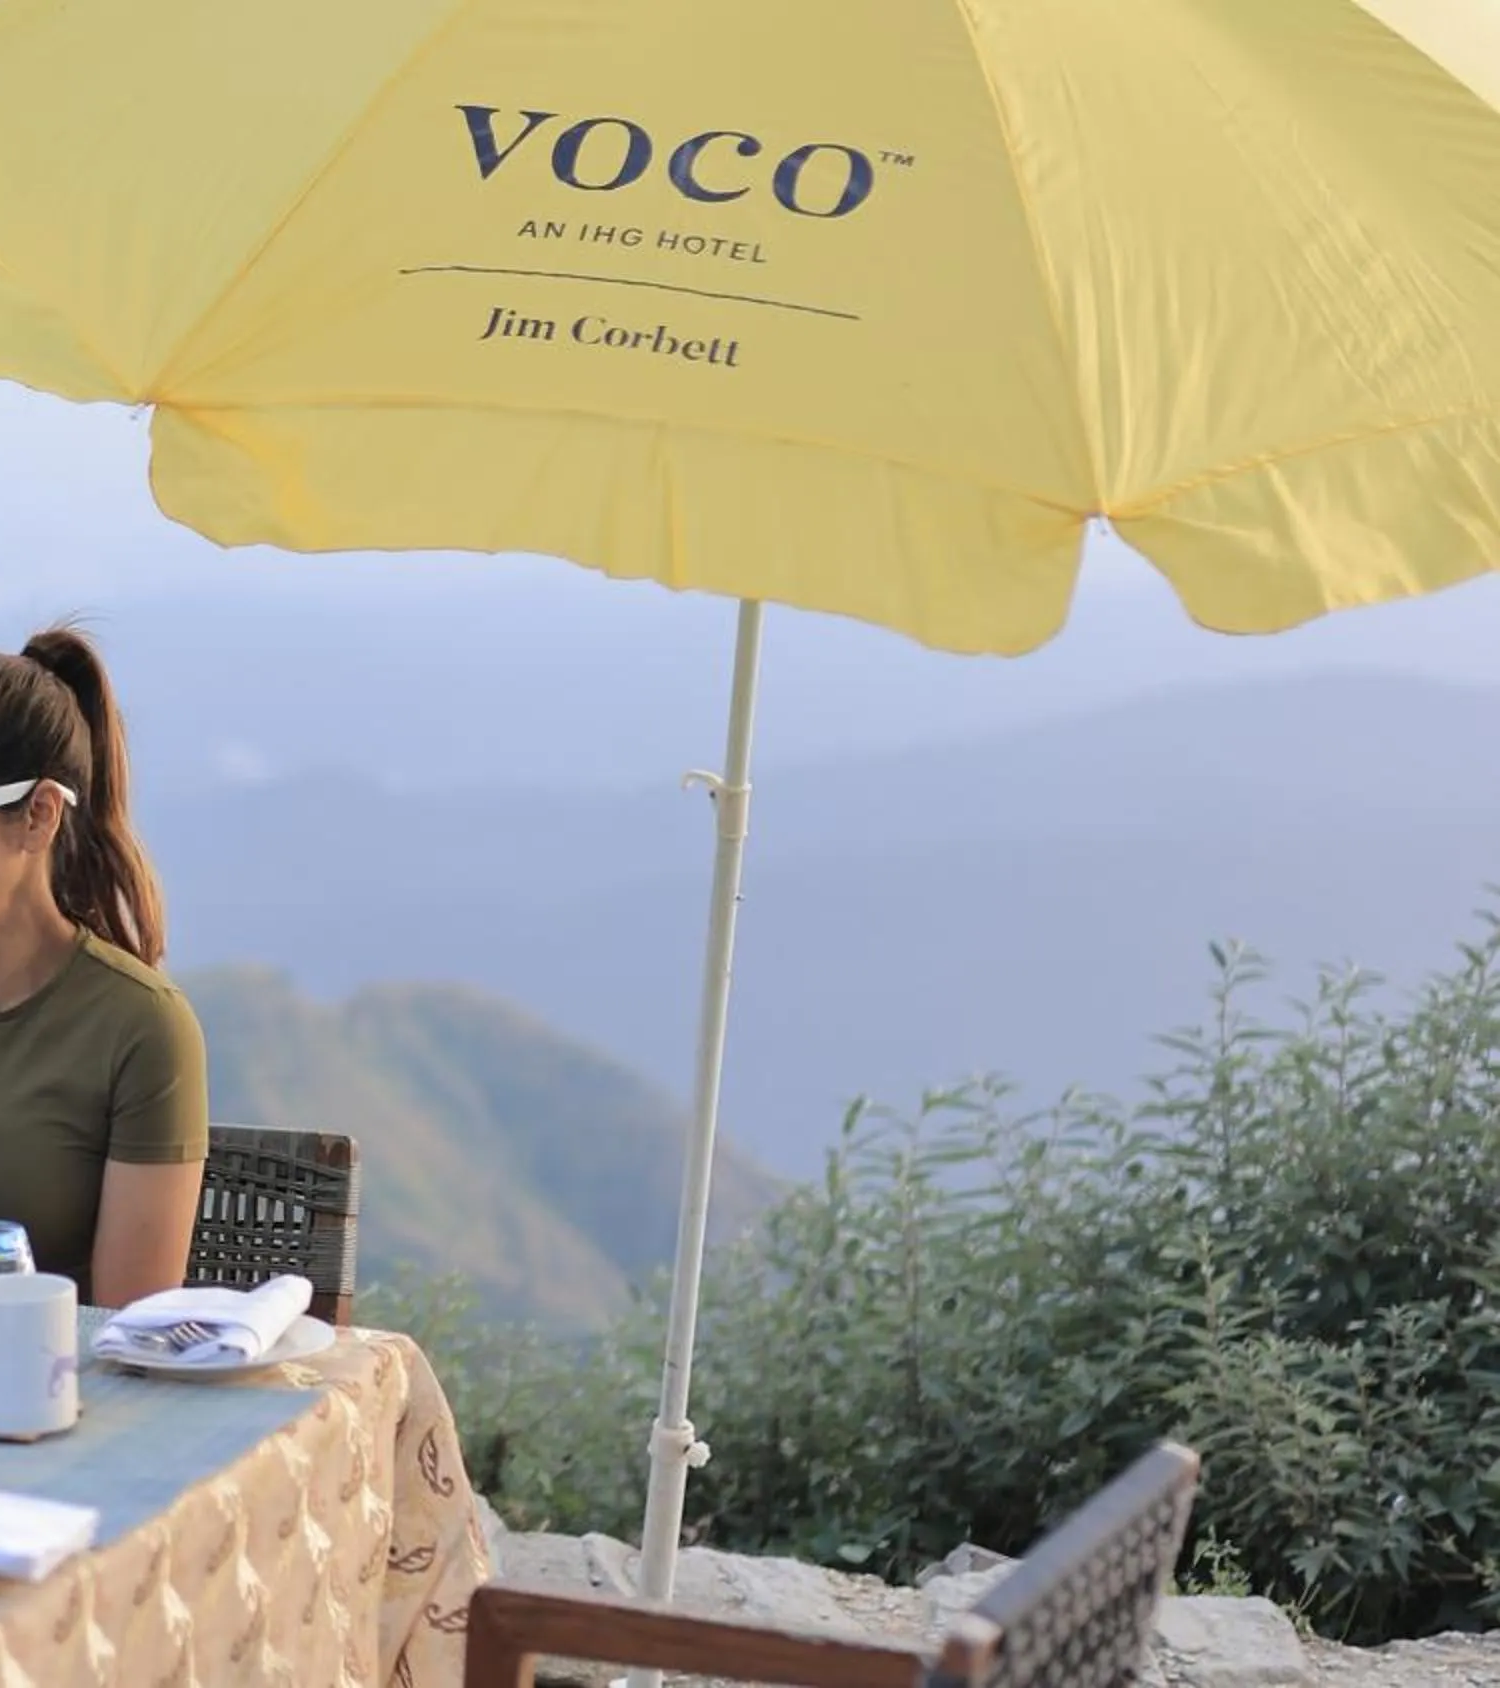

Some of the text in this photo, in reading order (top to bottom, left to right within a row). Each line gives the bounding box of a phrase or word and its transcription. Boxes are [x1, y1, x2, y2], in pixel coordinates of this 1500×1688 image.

[516, 219, 768, 264] AN IHG HOTEL
[479, 306, 741, 369] Jim Corbett
